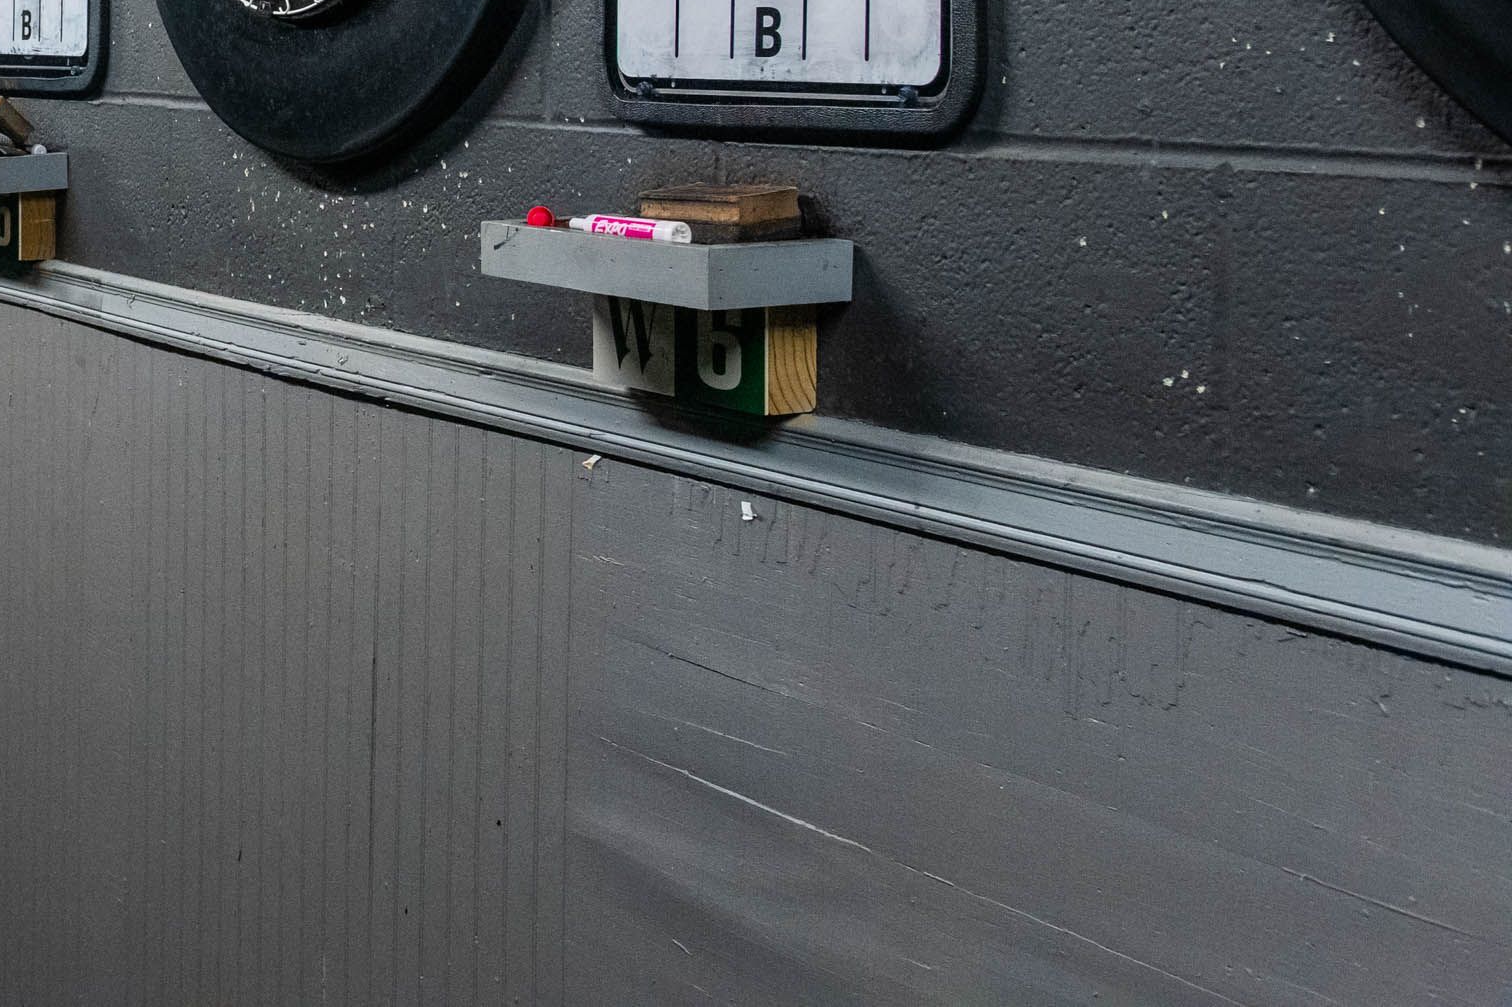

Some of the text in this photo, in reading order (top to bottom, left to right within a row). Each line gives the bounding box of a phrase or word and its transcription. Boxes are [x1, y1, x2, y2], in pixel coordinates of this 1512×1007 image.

[21, 9, 32, 41] B
[754, 6, 782, 58] B
[594, 219, 627, 237] EXPO
[696, 308, 743, 391] 6
